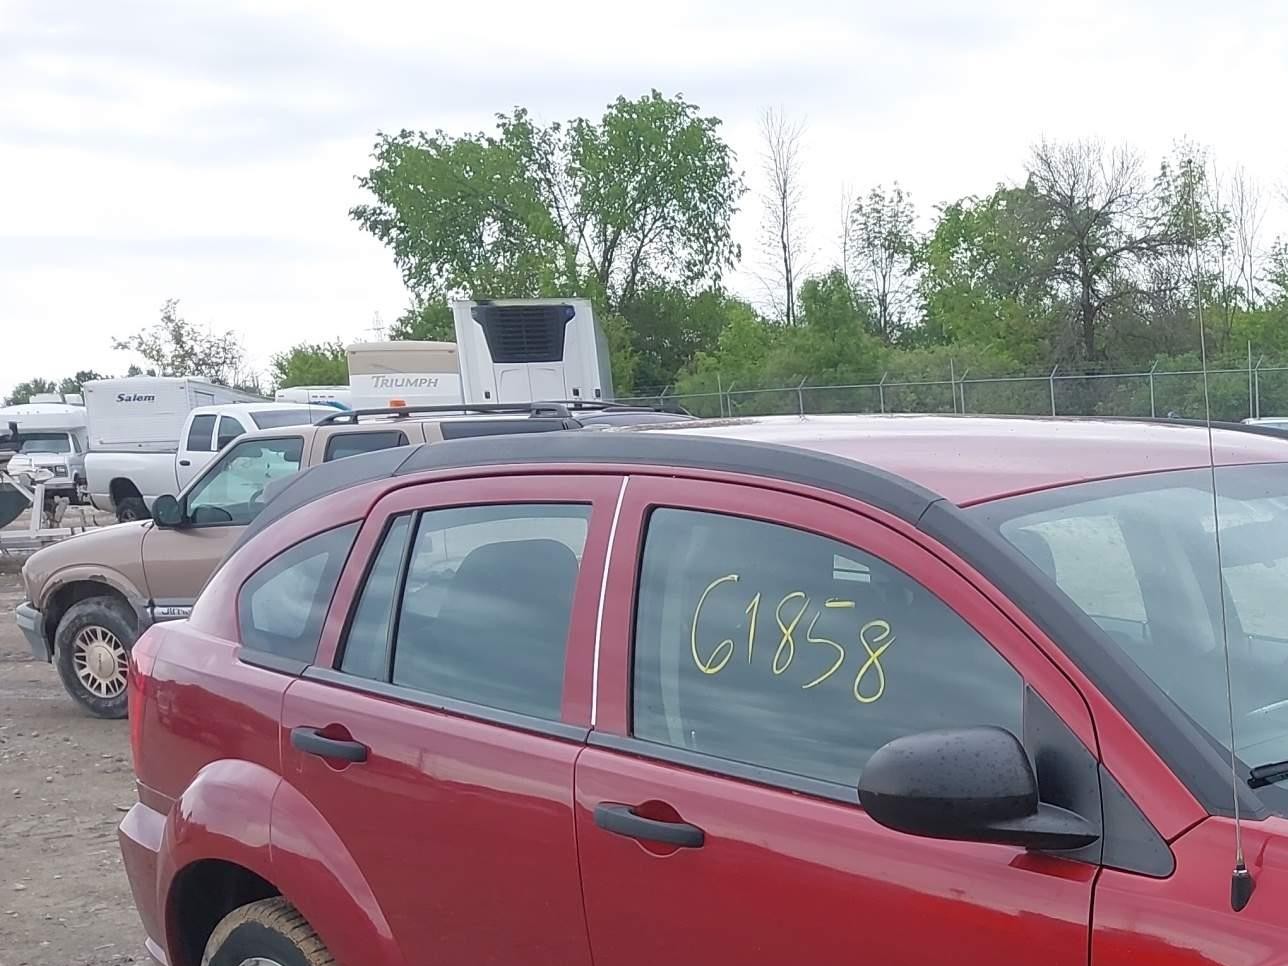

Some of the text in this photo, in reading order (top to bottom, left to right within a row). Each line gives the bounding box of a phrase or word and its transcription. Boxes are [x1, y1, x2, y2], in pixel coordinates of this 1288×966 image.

[371, 375, 439, 388] TRIUMPH
[116, 393, 155, 402] Salem
[691, 574, 896, 703] 61858
